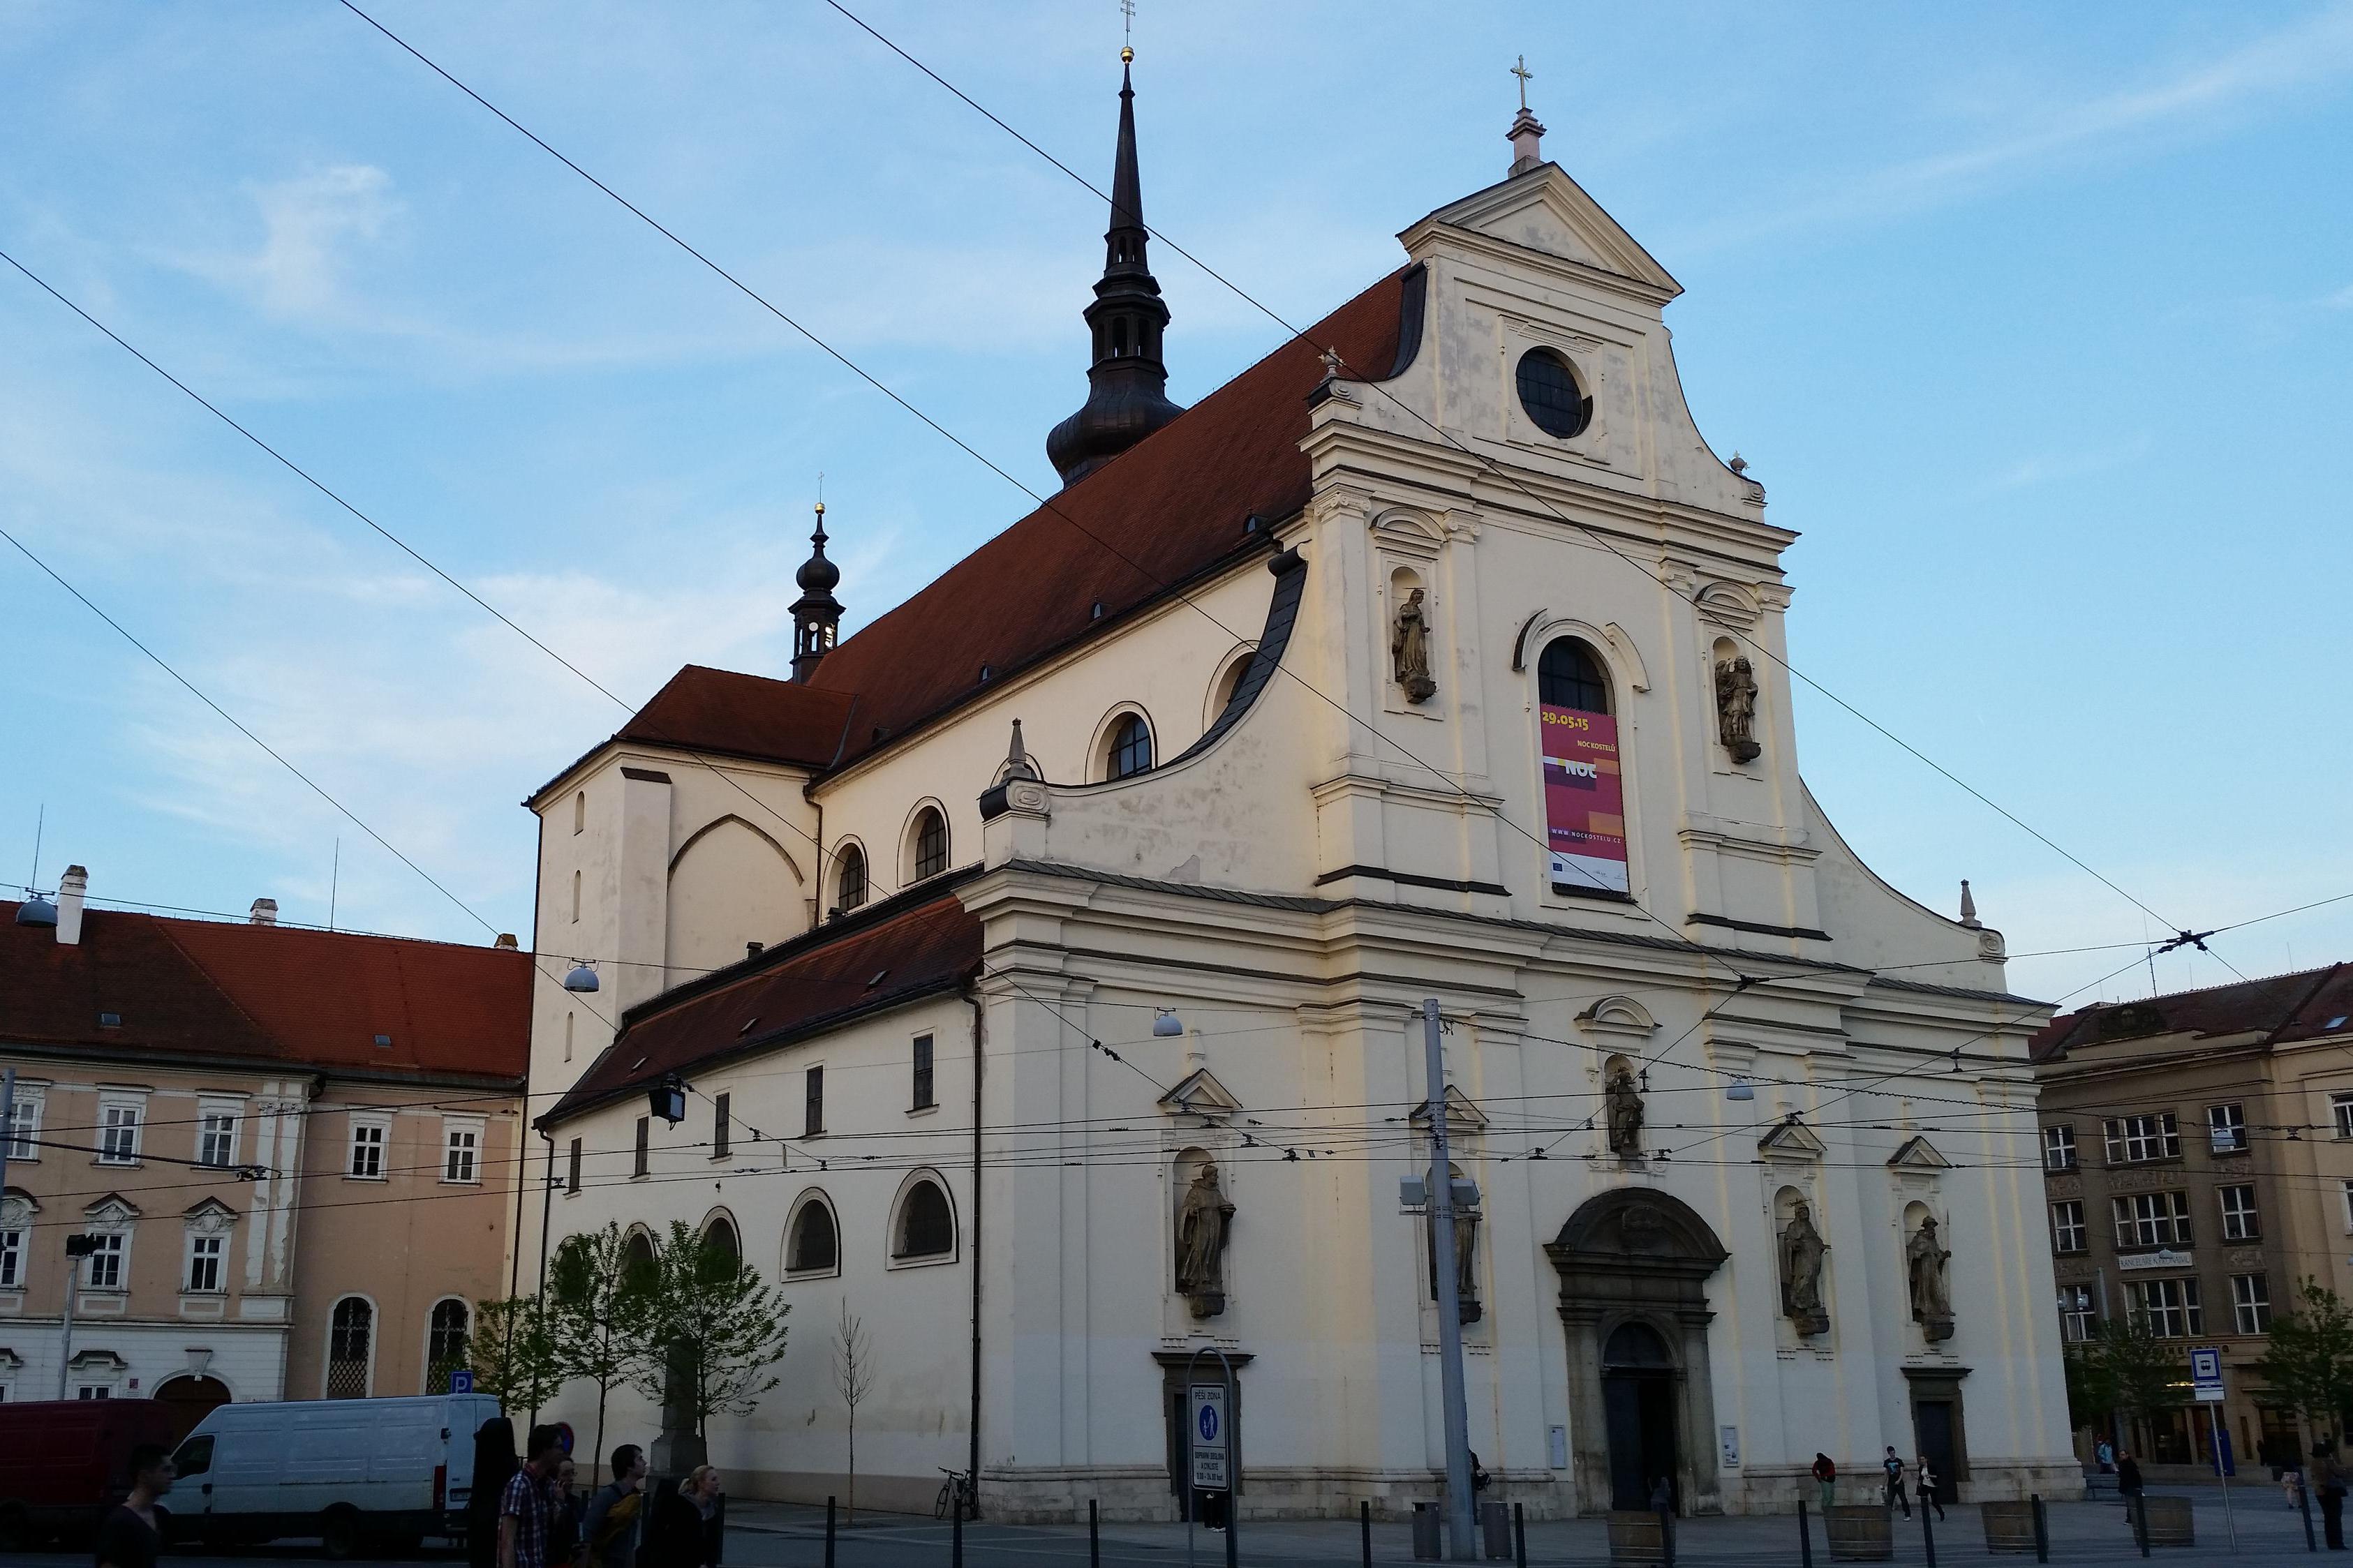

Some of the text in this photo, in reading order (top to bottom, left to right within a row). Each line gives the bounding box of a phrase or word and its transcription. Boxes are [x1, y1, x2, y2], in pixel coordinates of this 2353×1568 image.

[1542, 711, 1589, 731] 29.05.15
[1578, 740, 1615, 752] NOC KOSTELŮ
[1566, 761, 1597, 779] NOC
[456, 1377, 468, 1394] P
